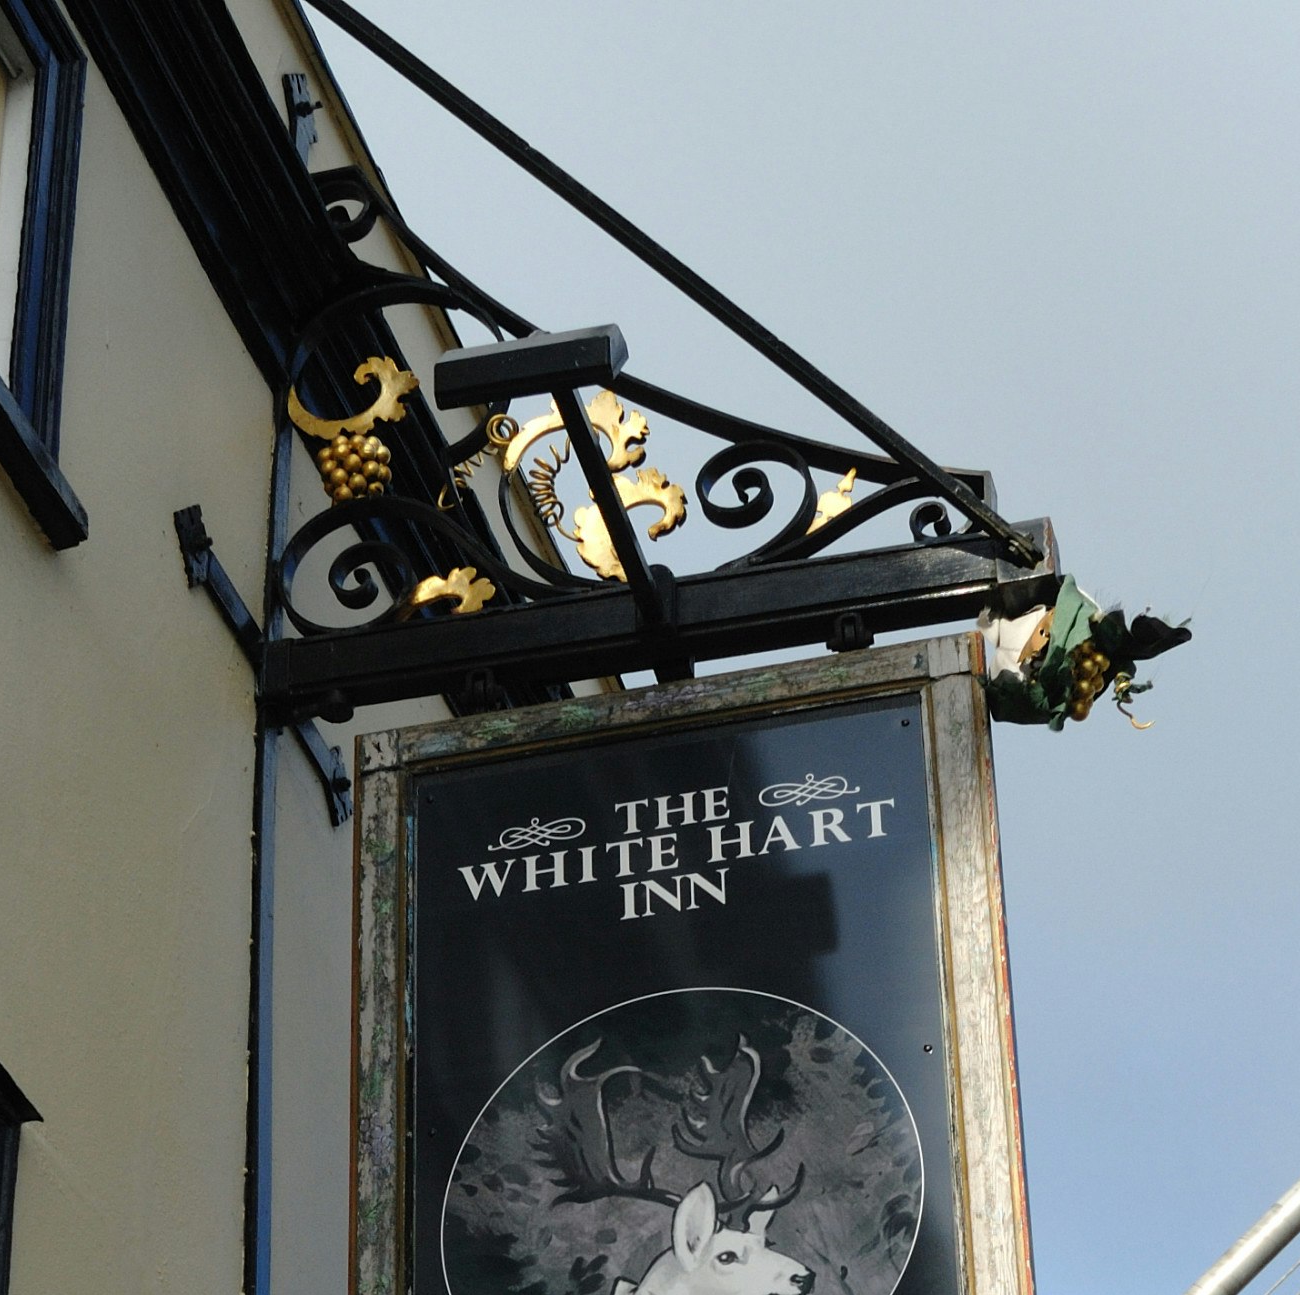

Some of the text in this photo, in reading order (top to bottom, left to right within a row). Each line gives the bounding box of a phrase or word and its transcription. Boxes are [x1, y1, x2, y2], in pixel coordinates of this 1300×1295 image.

[614, 786, 730, 835] THE
[457, 797, 895, 901] WHITE HART
[619, 867, 729, 921] INN
